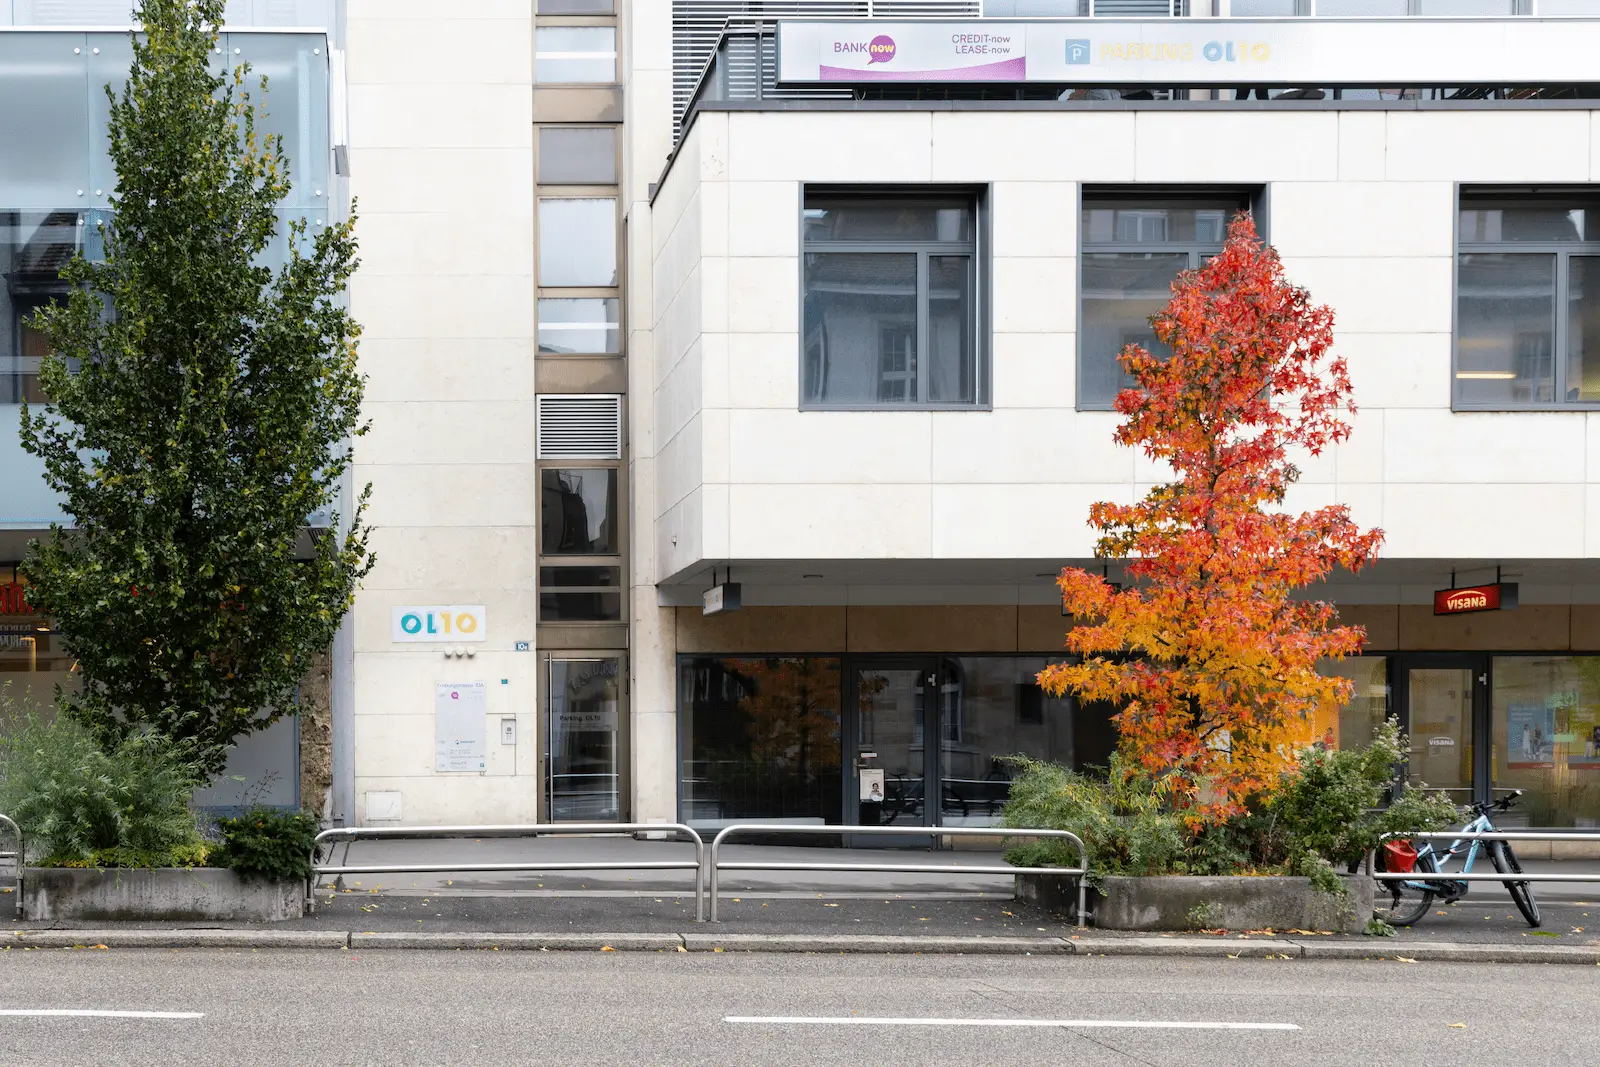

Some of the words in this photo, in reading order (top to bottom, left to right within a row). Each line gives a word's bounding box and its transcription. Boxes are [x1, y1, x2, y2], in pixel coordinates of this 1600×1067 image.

[952, 34, 1010, 44] CREDIT-now
[834, 42, 868, 53] BANK
[870, 44, 895, 53] now
[955, 45, 1010, 54] LEASE-now
[1101, 43, 1193, 61] PARKING
[1203, 41, 1270, 62] OL10
[401, 612, 477, 634] OL10
